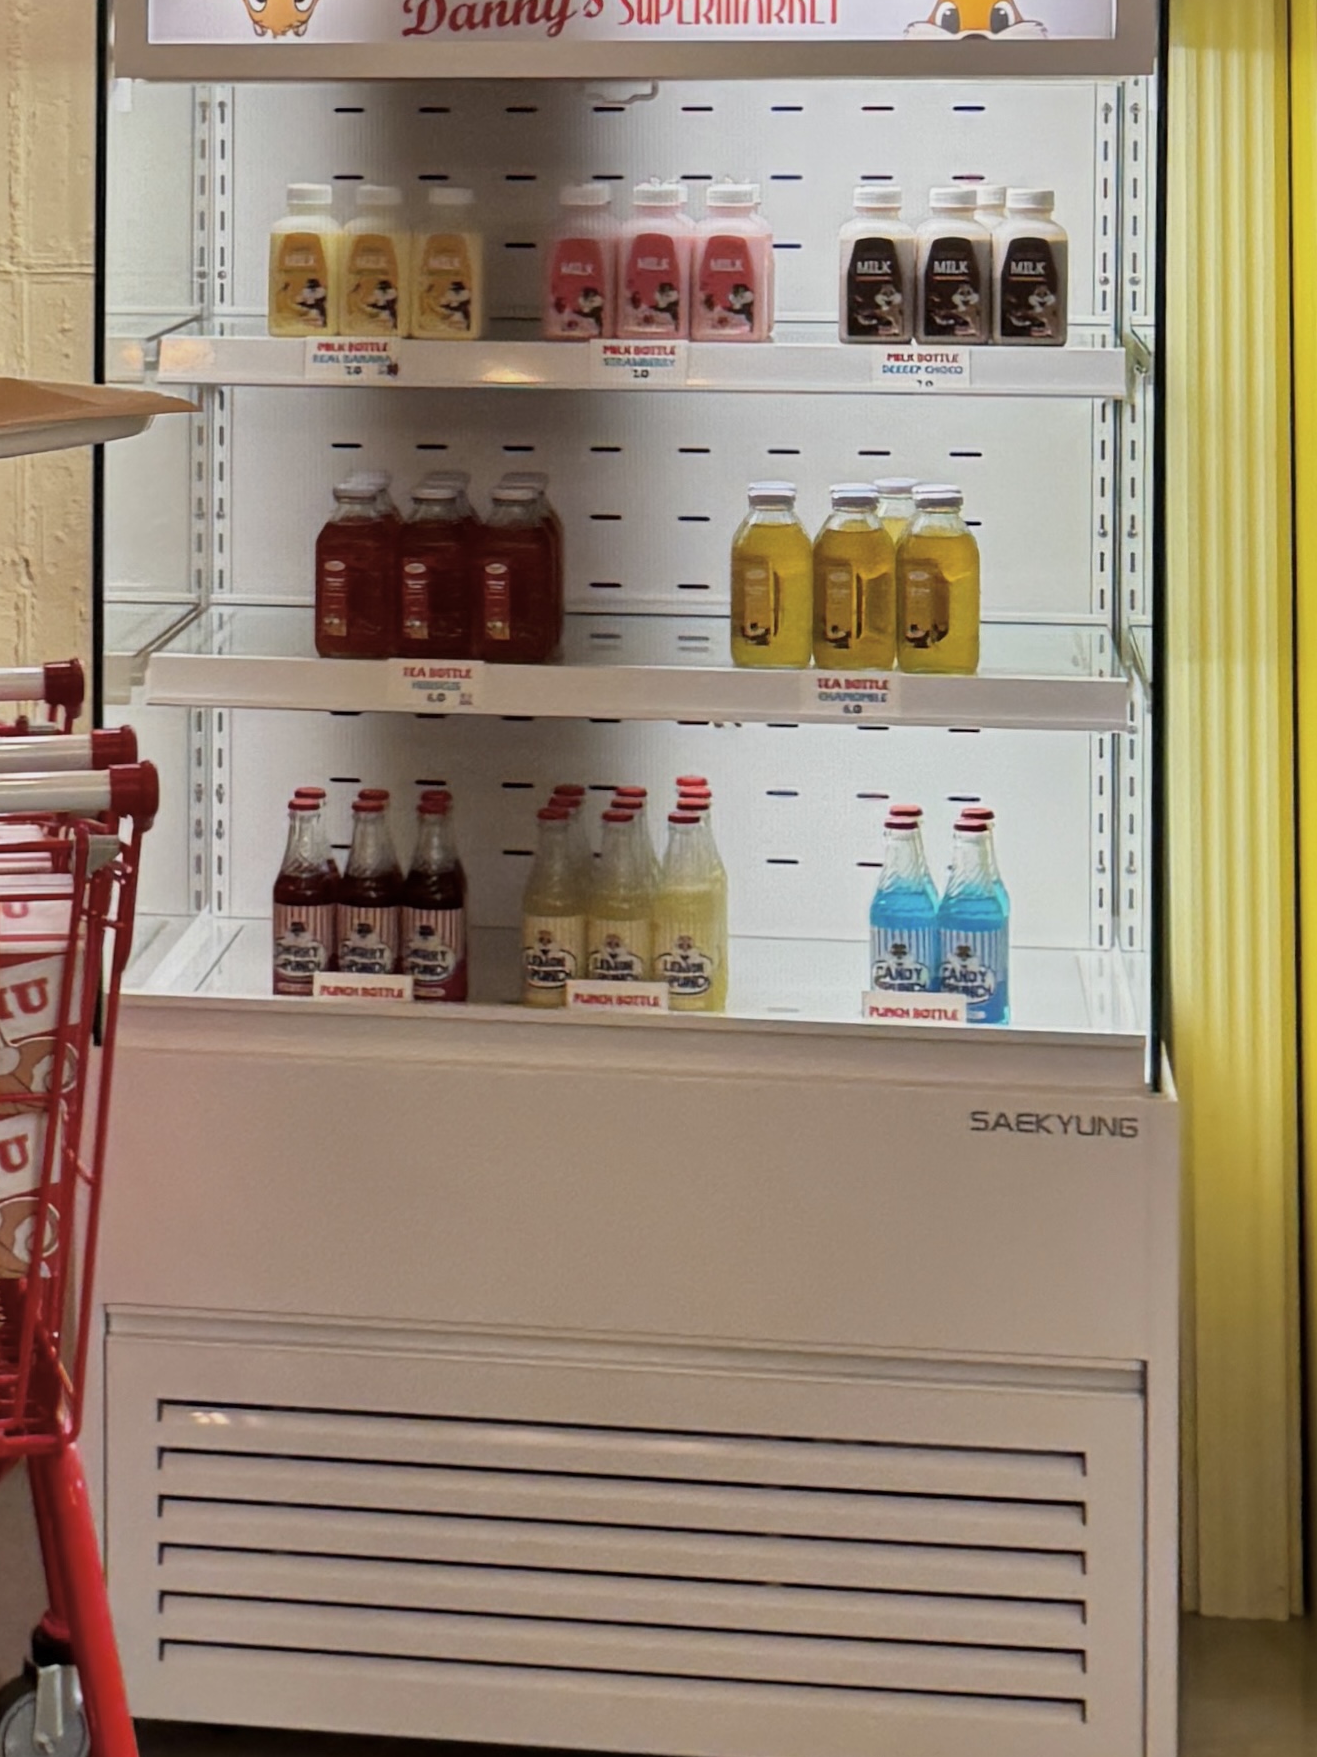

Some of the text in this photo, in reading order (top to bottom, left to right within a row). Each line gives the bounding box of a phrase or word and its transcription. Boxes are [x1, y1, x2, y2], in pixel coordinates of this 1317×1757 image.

[856, 260, 892, 275] MILK
[933, 260, 968, 275] MILK
[1010, 261, 1047, 275] MILK
[886, 353, 959, 363] MILK BOTTLE
[817, 678, 889, 690] TEA BOTTLE
[874, 965, 923, 982] CANDY
[941, 969, 987, 984] CANDY
[616, 994, 661, 1007] BOTTLE
[868, 1007, 959, 1021] PUNCH BOTTLE
[970, 1111, 1139, 1139] SAEKYUNG
